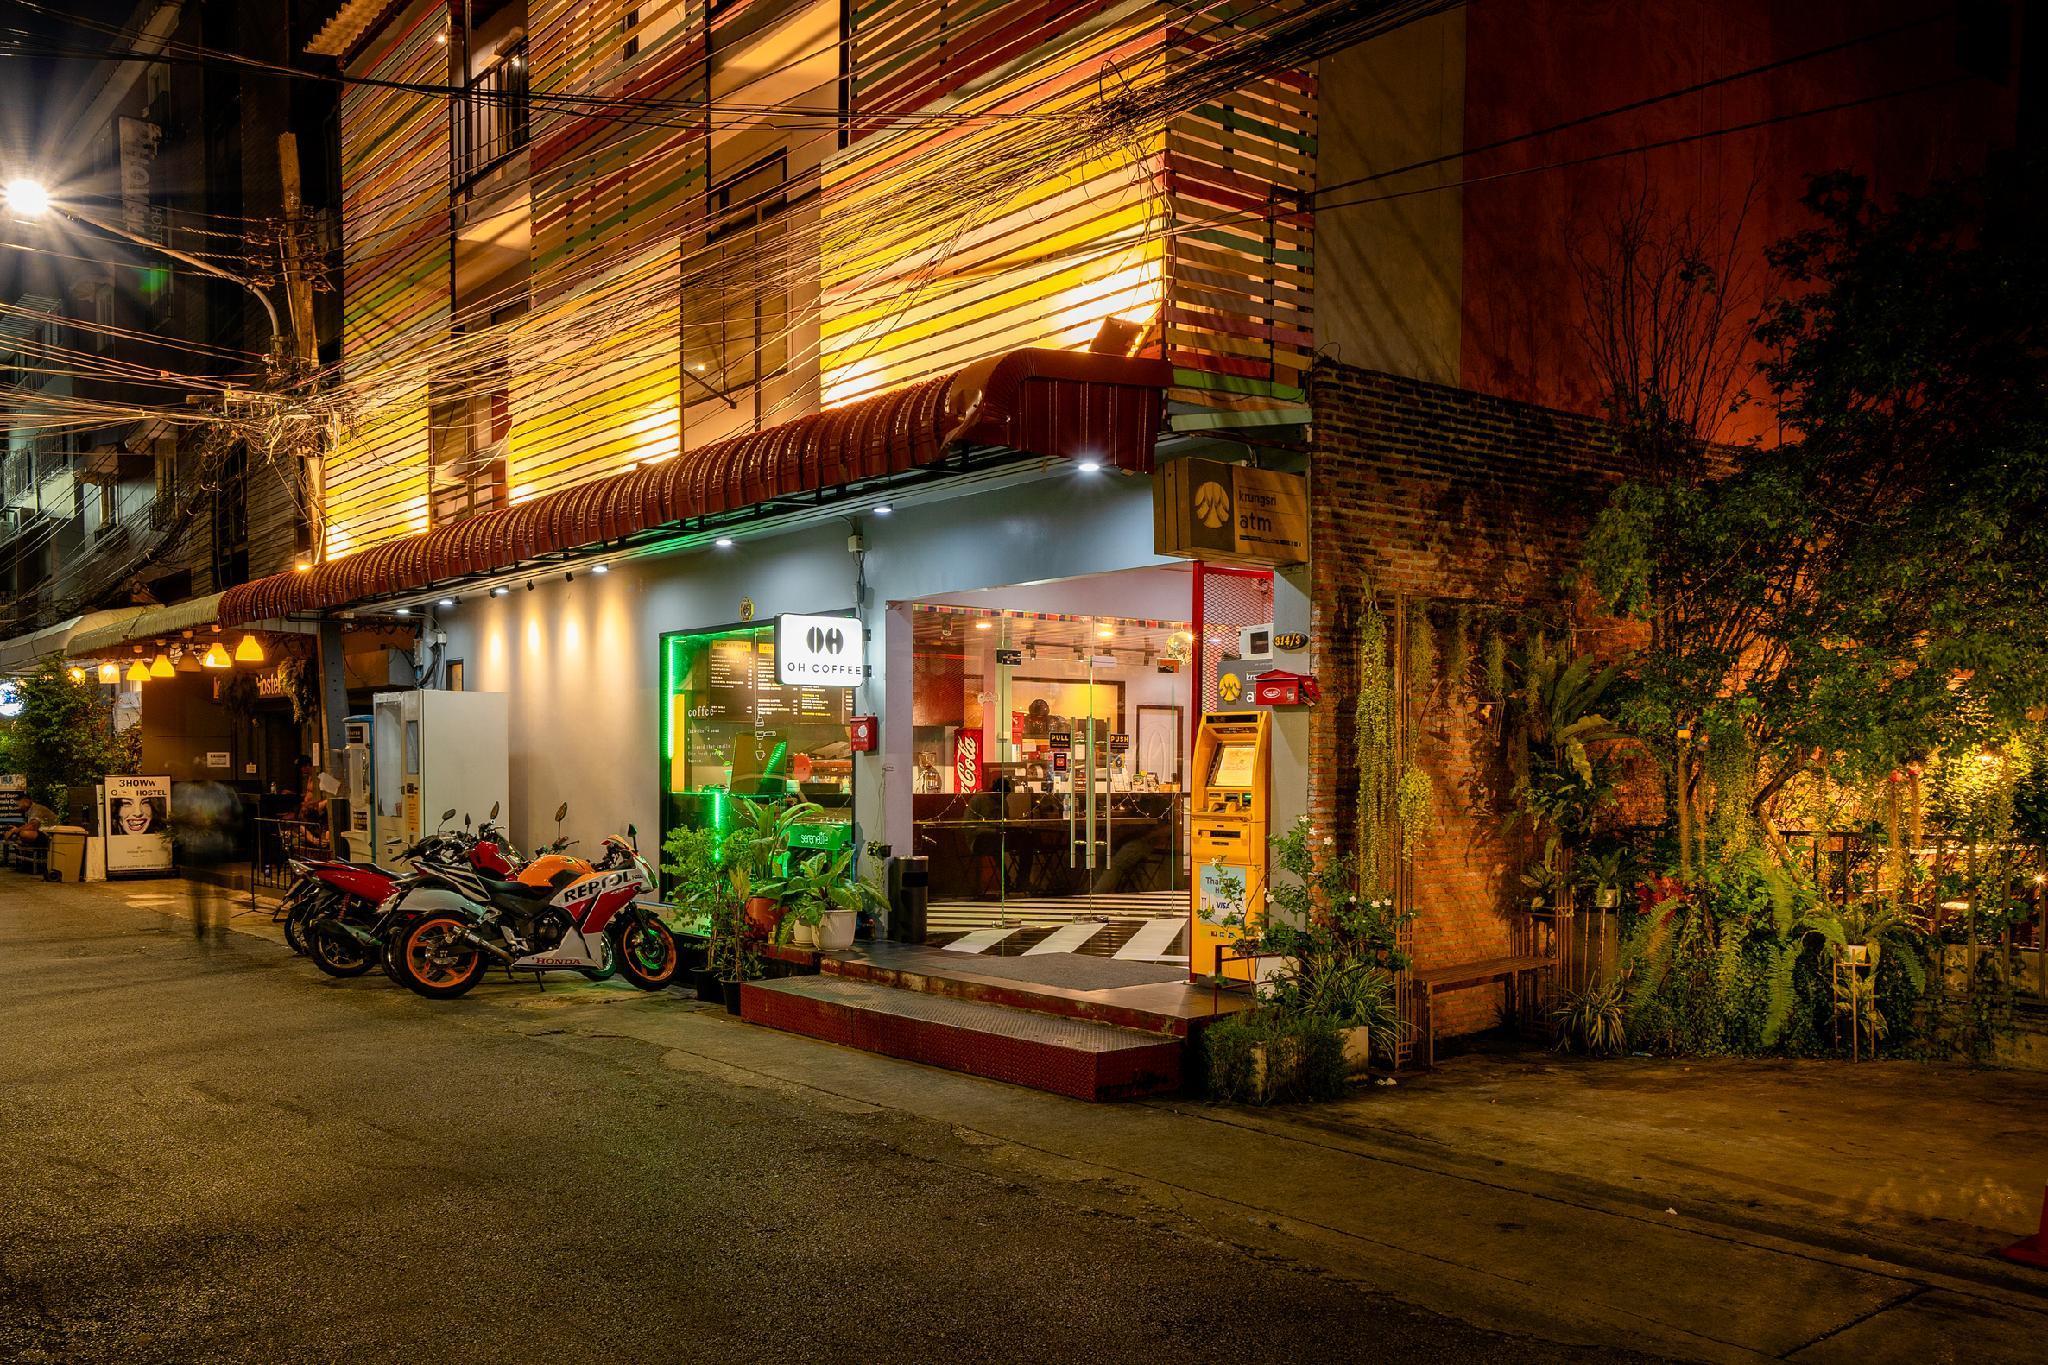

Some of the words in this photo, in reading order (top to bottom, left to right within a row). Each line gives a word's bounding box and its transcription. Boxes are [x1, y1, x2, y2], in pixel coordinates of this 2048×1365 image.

[1239, 511, 1272, 532] atm
[787, 662, 806, 673] OH
[811, 664, 862, 675] COFFEE
[956, 735, 977, 788] Cola
[136, 789, 168, 797] HOSTEL
[535, 957, 582, 965] HONDA
